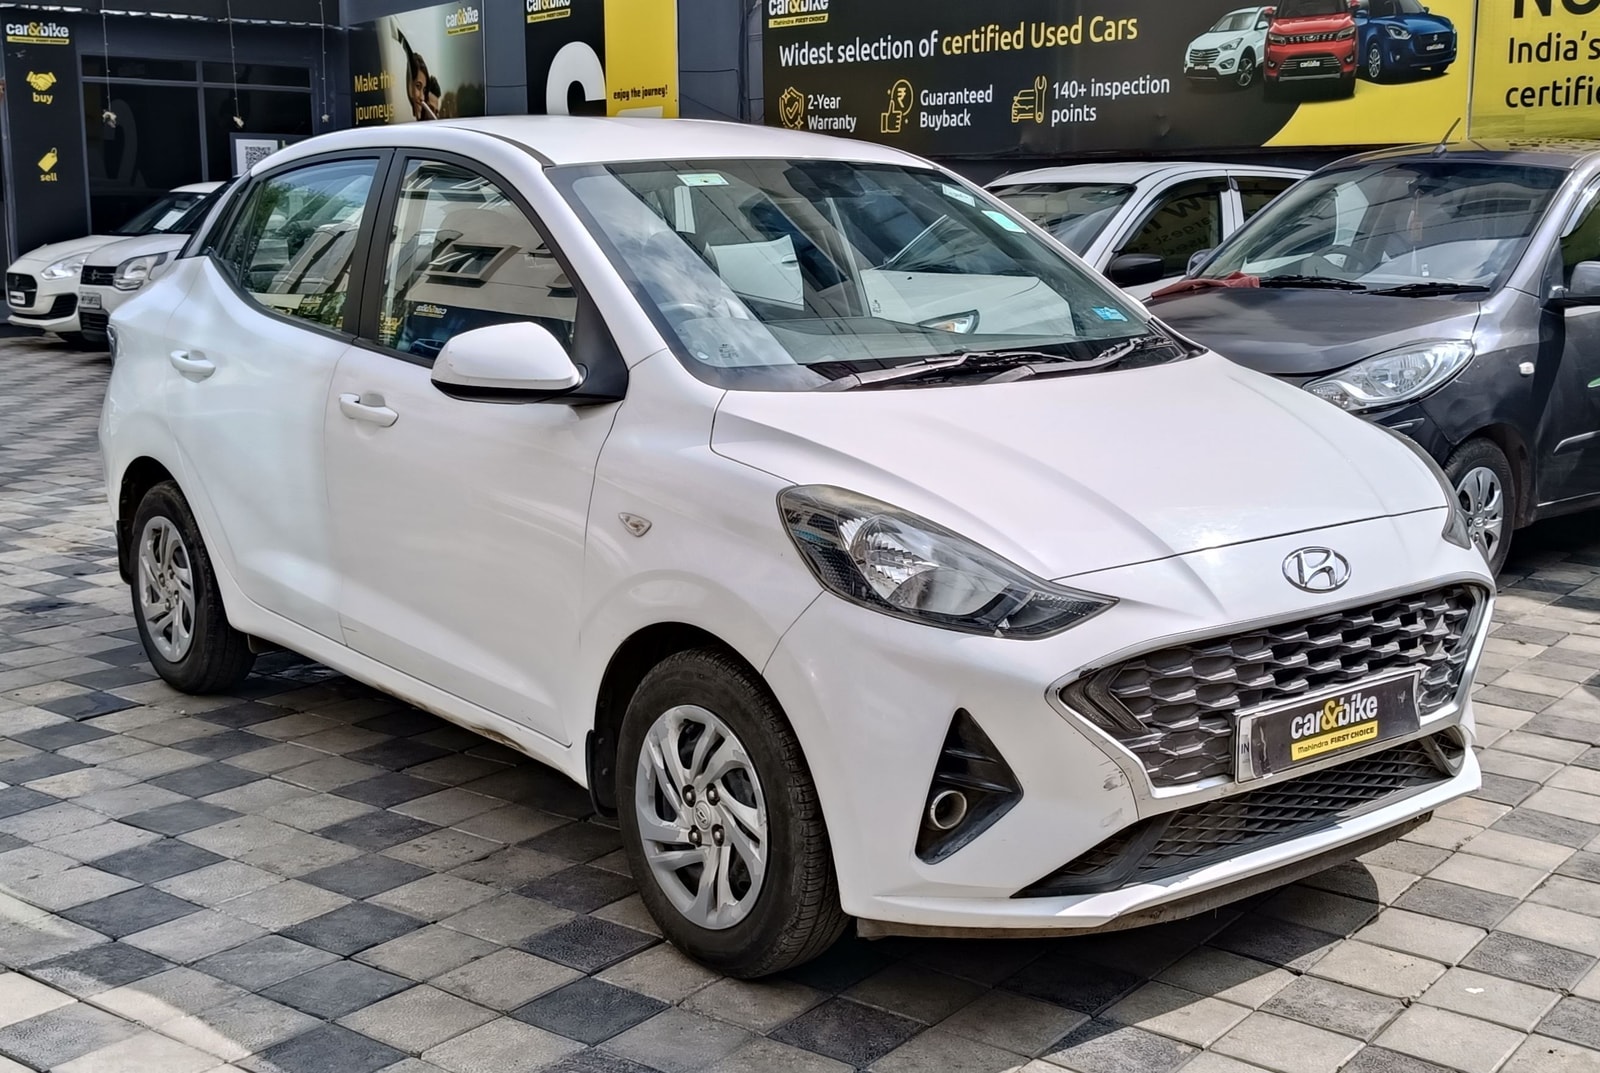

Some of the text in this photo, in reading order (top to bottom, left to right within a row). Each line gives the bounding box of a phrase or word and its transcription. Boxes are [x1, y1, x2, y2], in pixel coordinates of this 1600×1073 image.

[445, 6, 479, 27] car&bike
[6, 22, 69, 37] car&bike
[779, 15, 1138, 67] Widest selection of certified Used Cars
[354, 70, 396, 93] Make th
[1053, 74, 1170, 100] 140+ inspection
[32, 92, 53, 105] buy
[613, 84, 668, 102] enjoy the journey!
[807, 94, 841, 110] 2-Year
[920, 84, 993, 106] Guaranteed
[807, 115, 857, 133] Warranty
[919, 108, 972, 131] Buyback
[1051, 103, 1097, 127] points
[40, 172, 58, 181] sell
[1291, 692, 1378, 740] car&bike
[1330, 733, 1350, 745] FIRST
[1350, 726, 1375, 740] CHOICE
